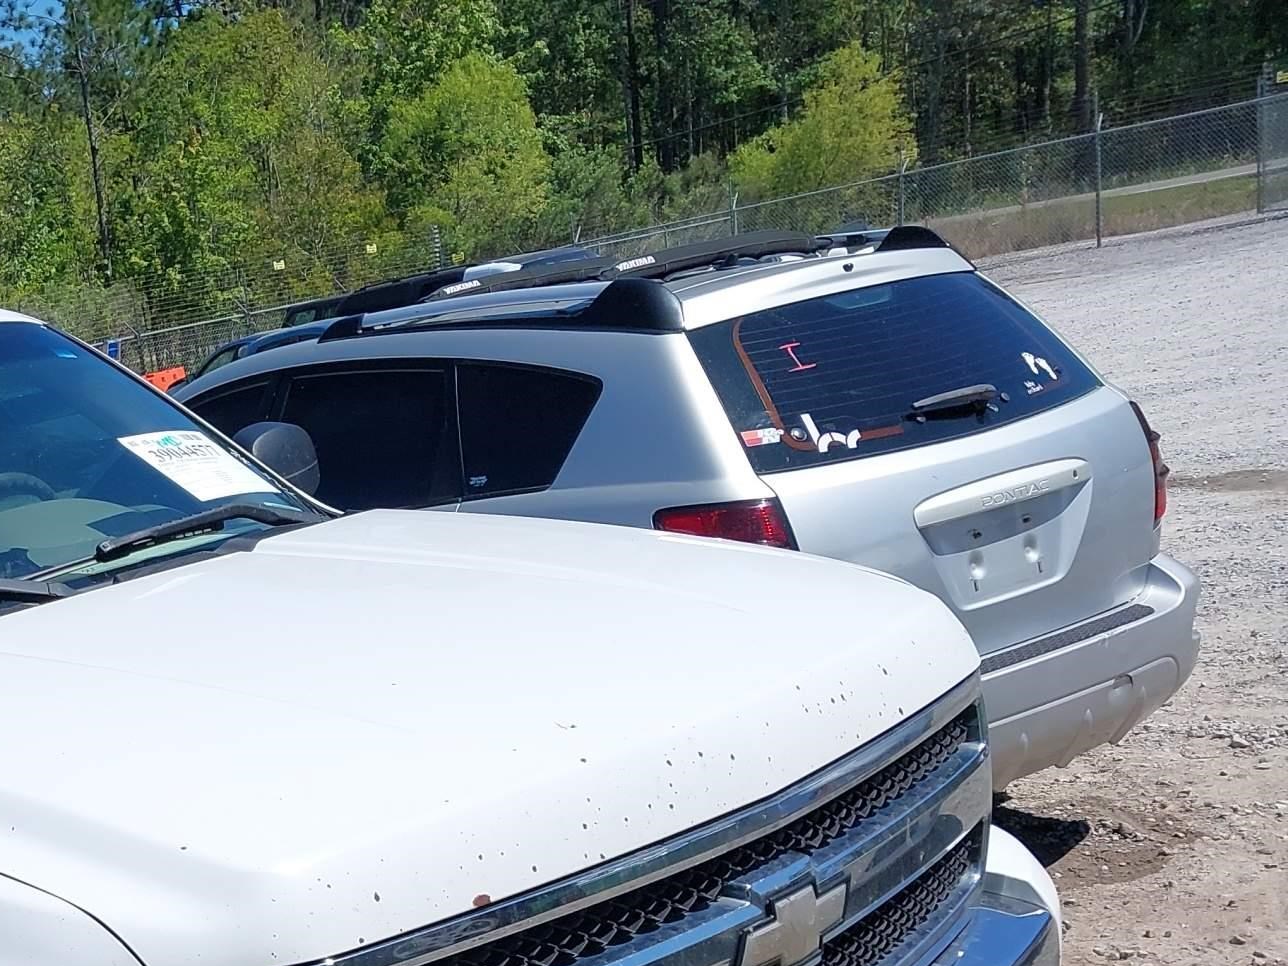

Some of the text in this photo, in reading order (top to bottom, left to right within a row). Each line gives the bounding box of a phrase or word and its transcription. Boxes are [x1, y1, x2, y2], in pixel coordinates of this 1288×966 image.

[616, 256, 656, 272] YAKIMA
[443, 279, 481, 295] YAKIMA
[147, 444, 221, 463] 39044577
[980, 479, 1049, 508] PONTIAC
